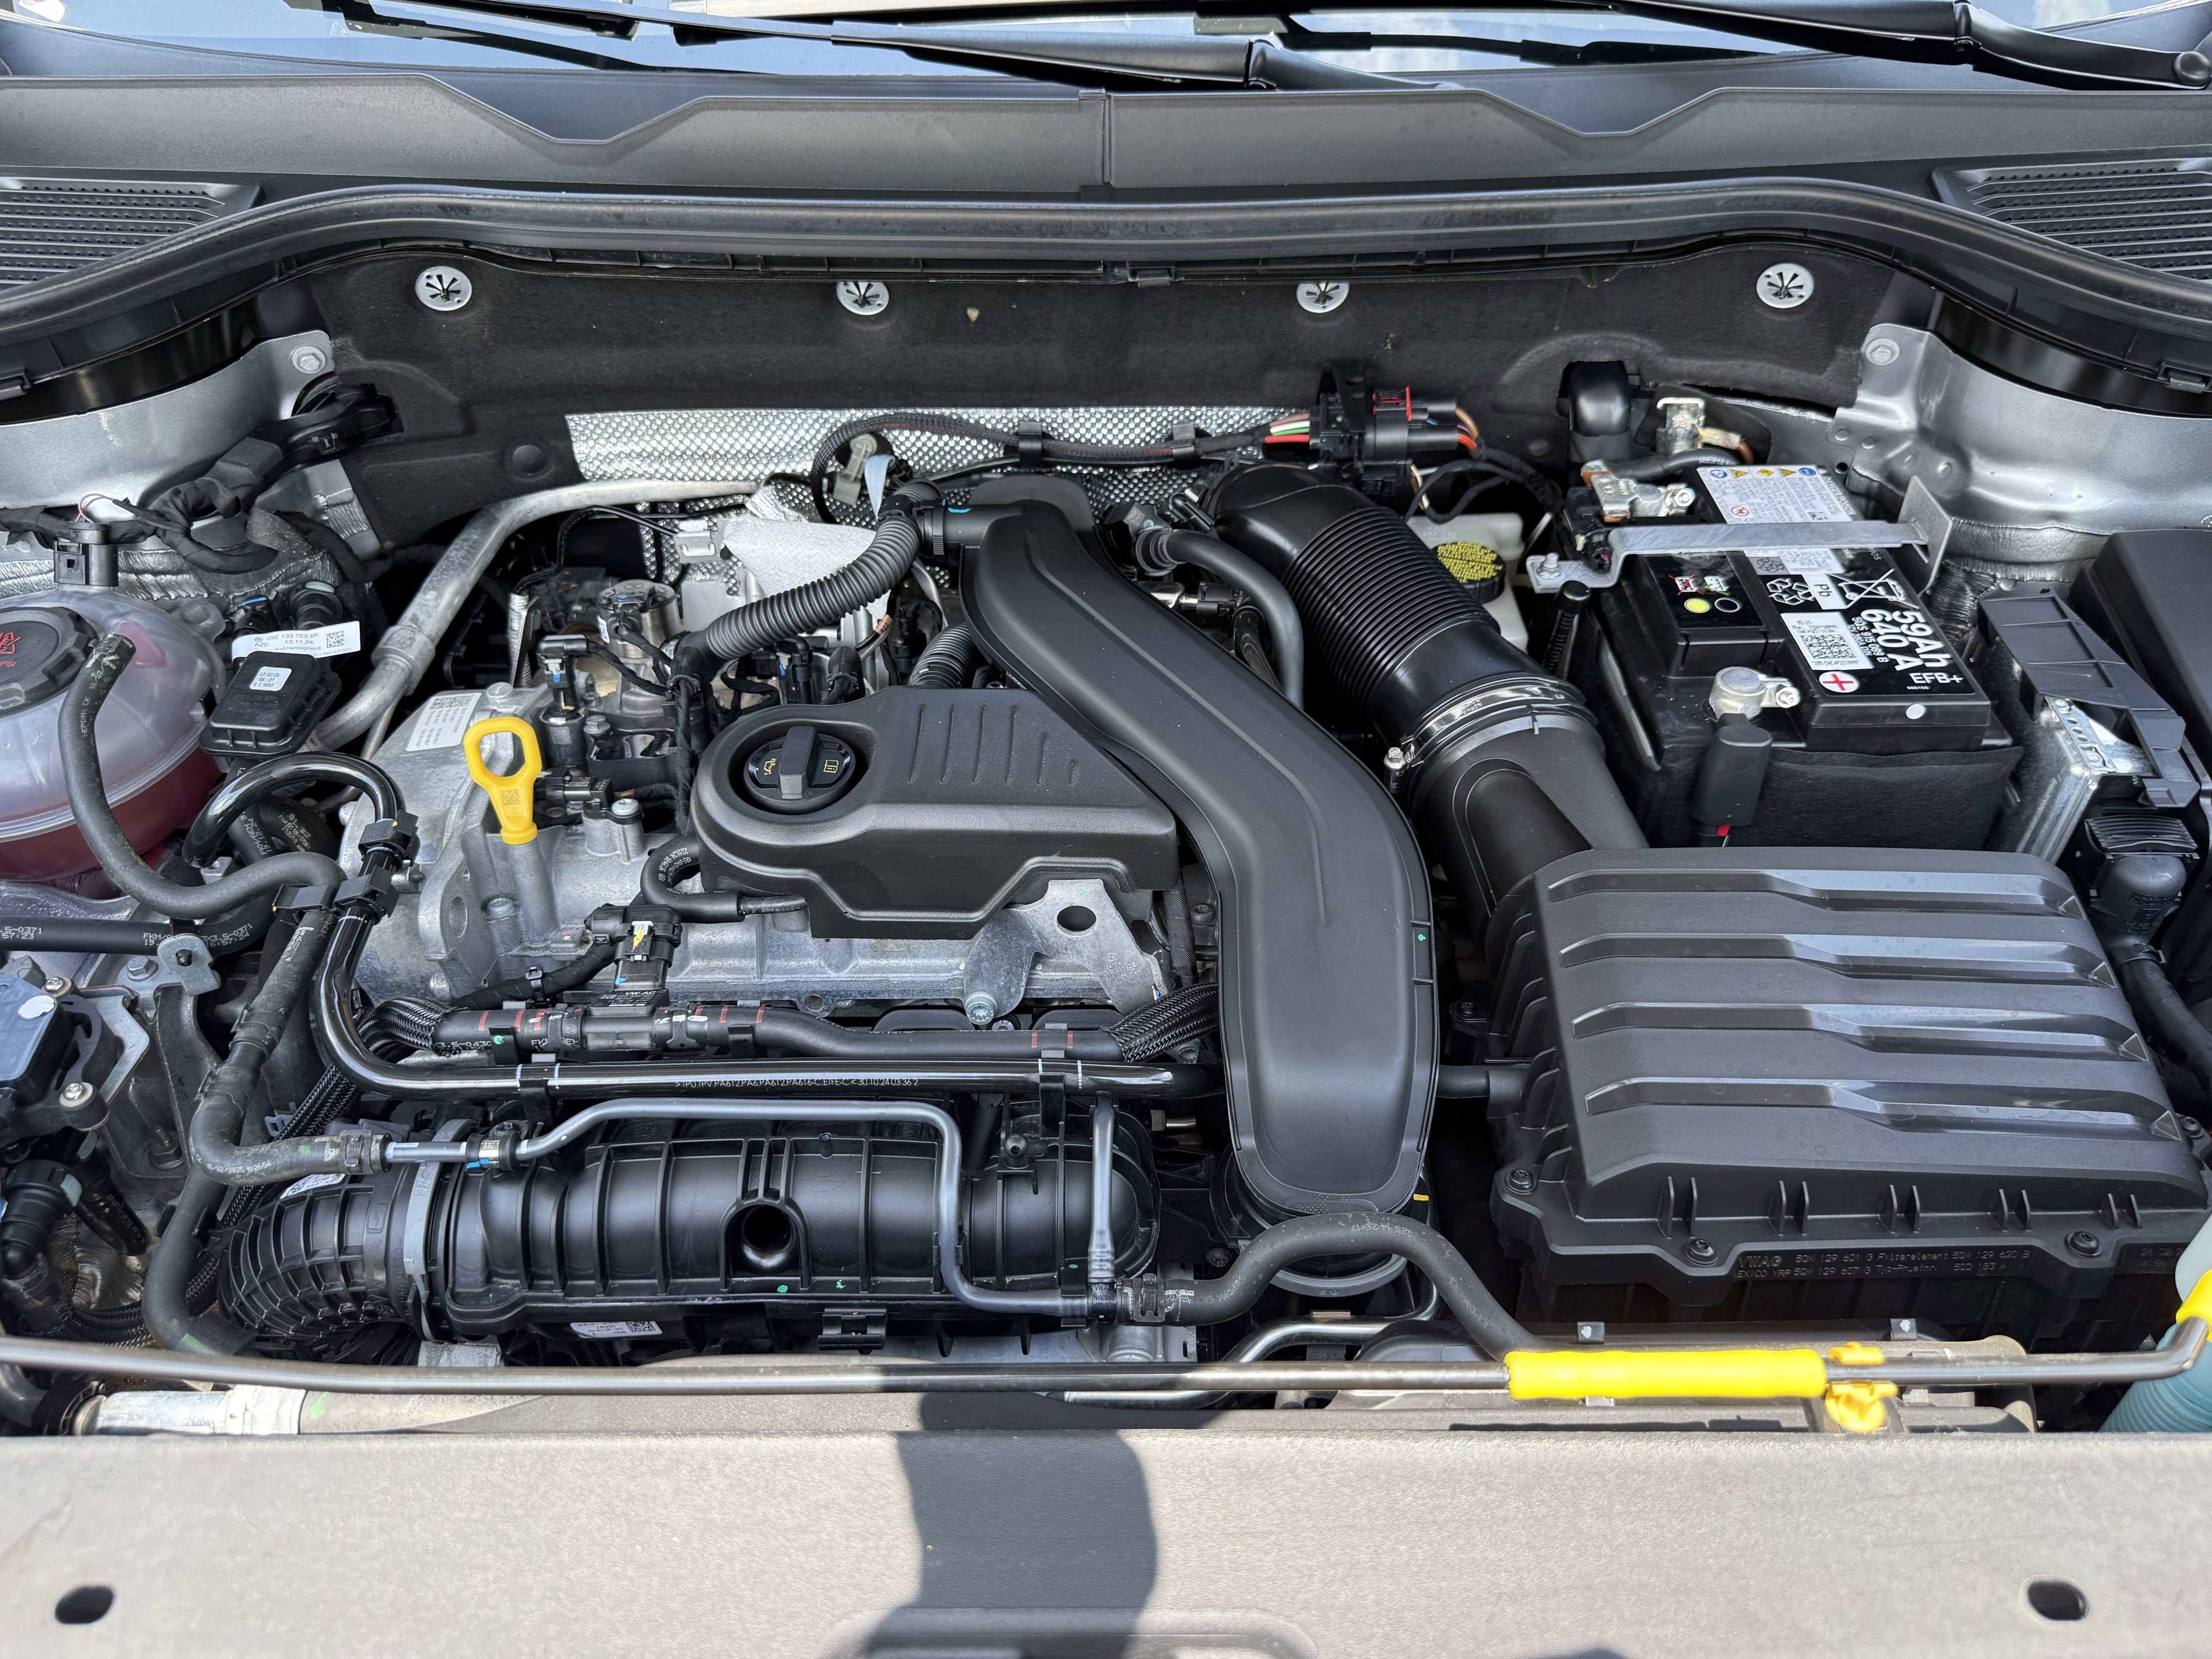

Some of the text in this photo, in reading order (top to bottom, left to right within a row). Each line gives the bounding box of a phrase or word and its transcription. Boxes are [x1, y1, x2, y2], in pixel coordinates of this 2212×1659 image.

[1813, 584, 1832, 597] Pb
[1860, 608, 1911, 648] 640
[1886, 653, 1924, 671] A
[1860, 631, 1876, 643] 915
[1868, 643, 1884, 656] 089
[1892, 610, 1951, 668] 59Ah
[1909, 672, 1965, 684] EFB+
